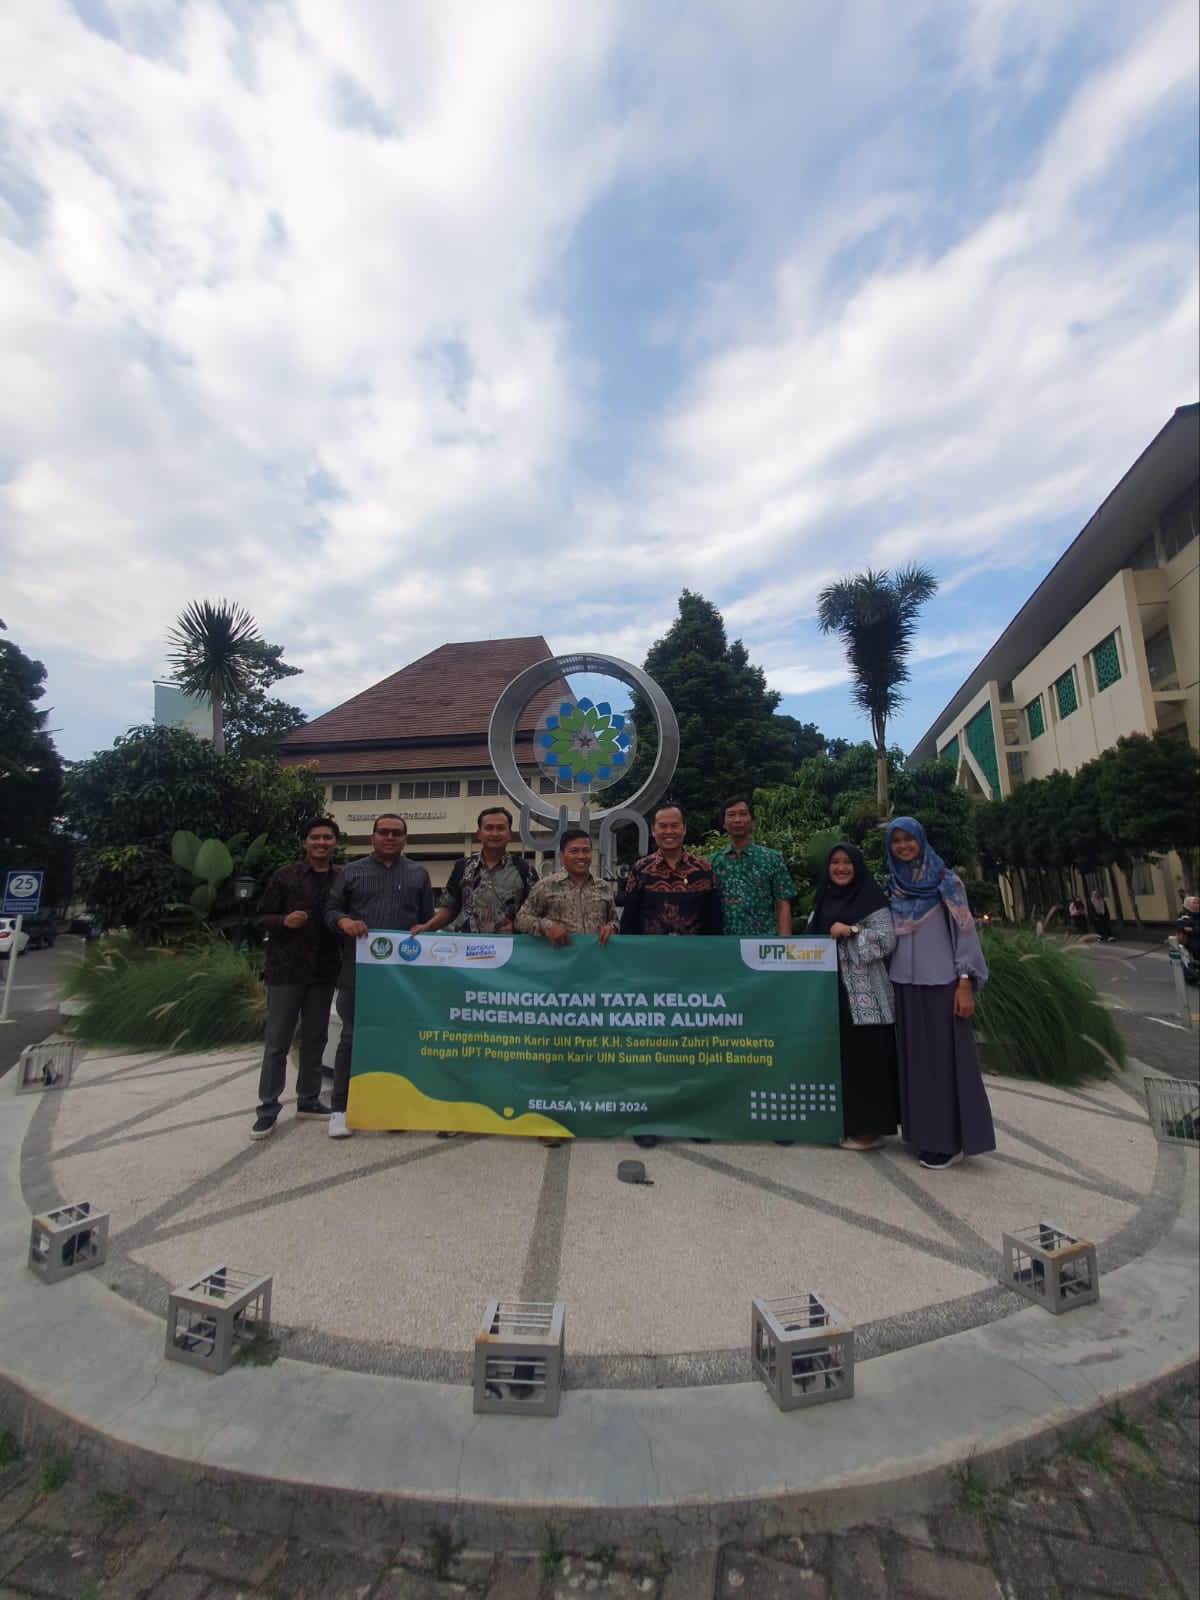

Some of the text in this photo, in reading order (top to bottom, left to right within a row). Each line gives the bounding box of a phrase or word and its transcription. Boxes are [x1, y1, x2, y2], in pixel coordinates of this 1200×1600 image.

[15, 878, 33, 890] 25
[465, 991, 727, 1007] PENINGKATAN TATA KELOLA
[449, 1007, 743, 1027] PENGEMBANGAN KARIR ALUMNI
[419, 1030, 439, 1041] UPT
[442, 1031, 521, 1046] Pengembangan
[524, 1034, 550, 1046] Karir
[553, 1036, 572, 1047] UIN
[574, 1036, 598, 1048] Prof.
[601, 1036, 622, 1048] K.H.
[680, 1036, 709, 1048] Zuhri
[712, 1036, 775, 1048] Purwokerto
[420, 1046, 773, 1067] dengan UPT Pengembangan Karir UIN Sunan Gunung Djati Bandung
[528, 1099, 648, 1113] SELASA, 14 MEI 2024
